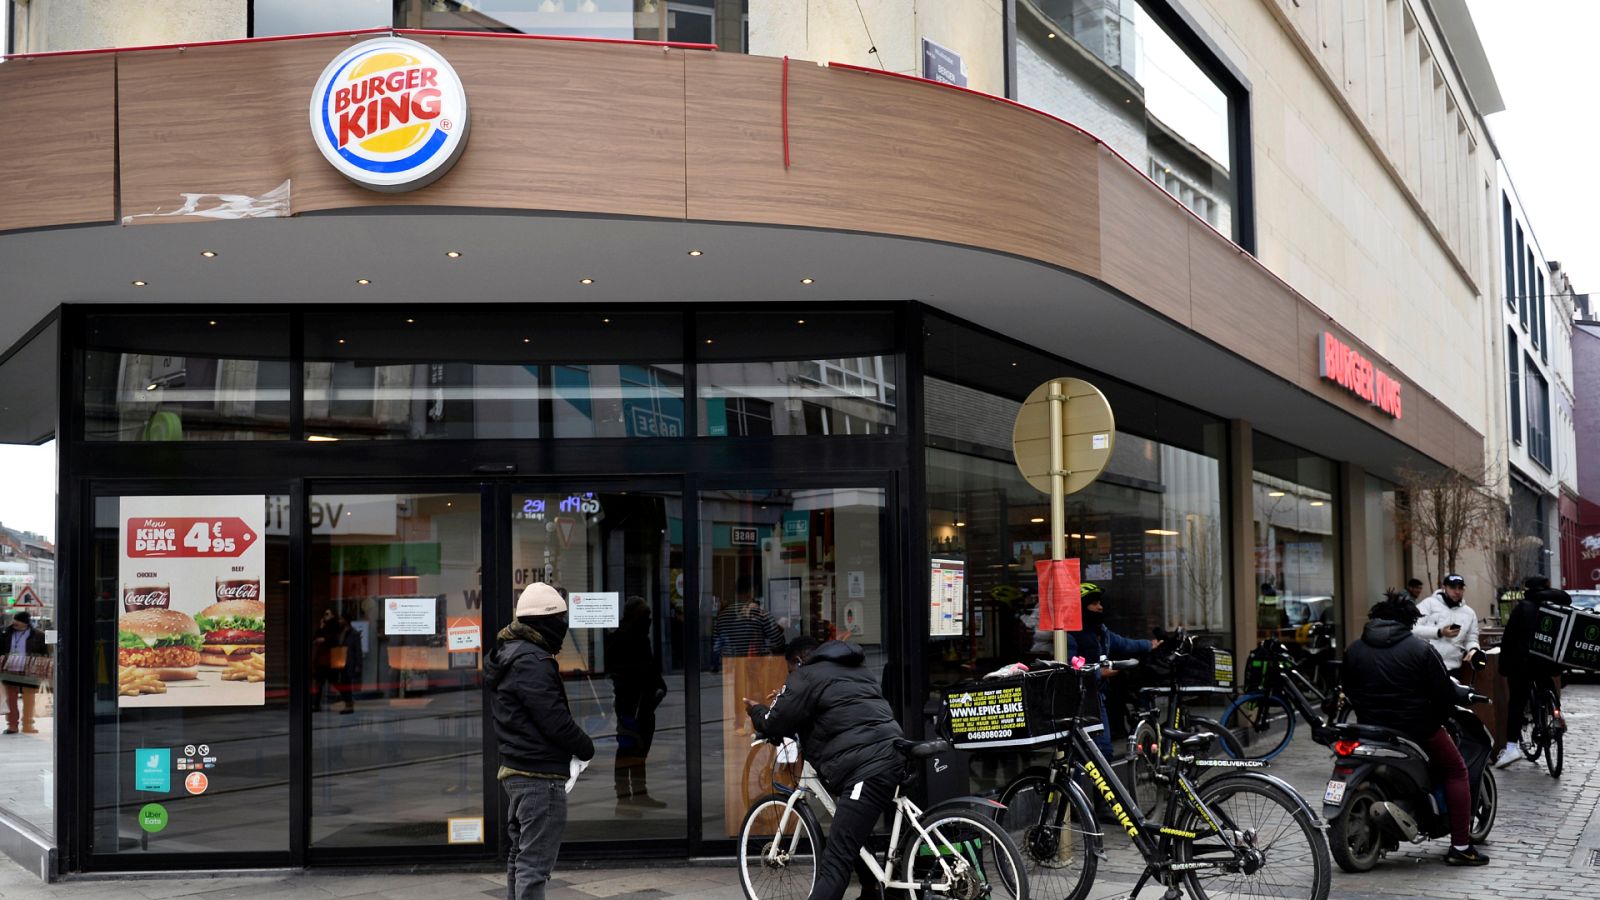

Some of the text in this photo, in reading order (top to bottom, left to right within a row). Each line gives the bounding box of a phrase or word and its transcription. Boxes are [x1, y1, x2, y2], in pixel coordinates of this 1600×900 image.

[335, 68, 438, 114] BURGER
[339, 88, 441, 147] KING
[1324, 331, 1402, 419] BURGER KING
[144, 519, 166, 527] Menu
[135, 540, 176, 551] DEAL
[515, 568, 528, 585] OF
[1534, 632, 1553, 643] UBER
[1575, 641, 1600, 653] UBER
[950, 702, 1023, 717] WWW.EPIKE.BIKE
